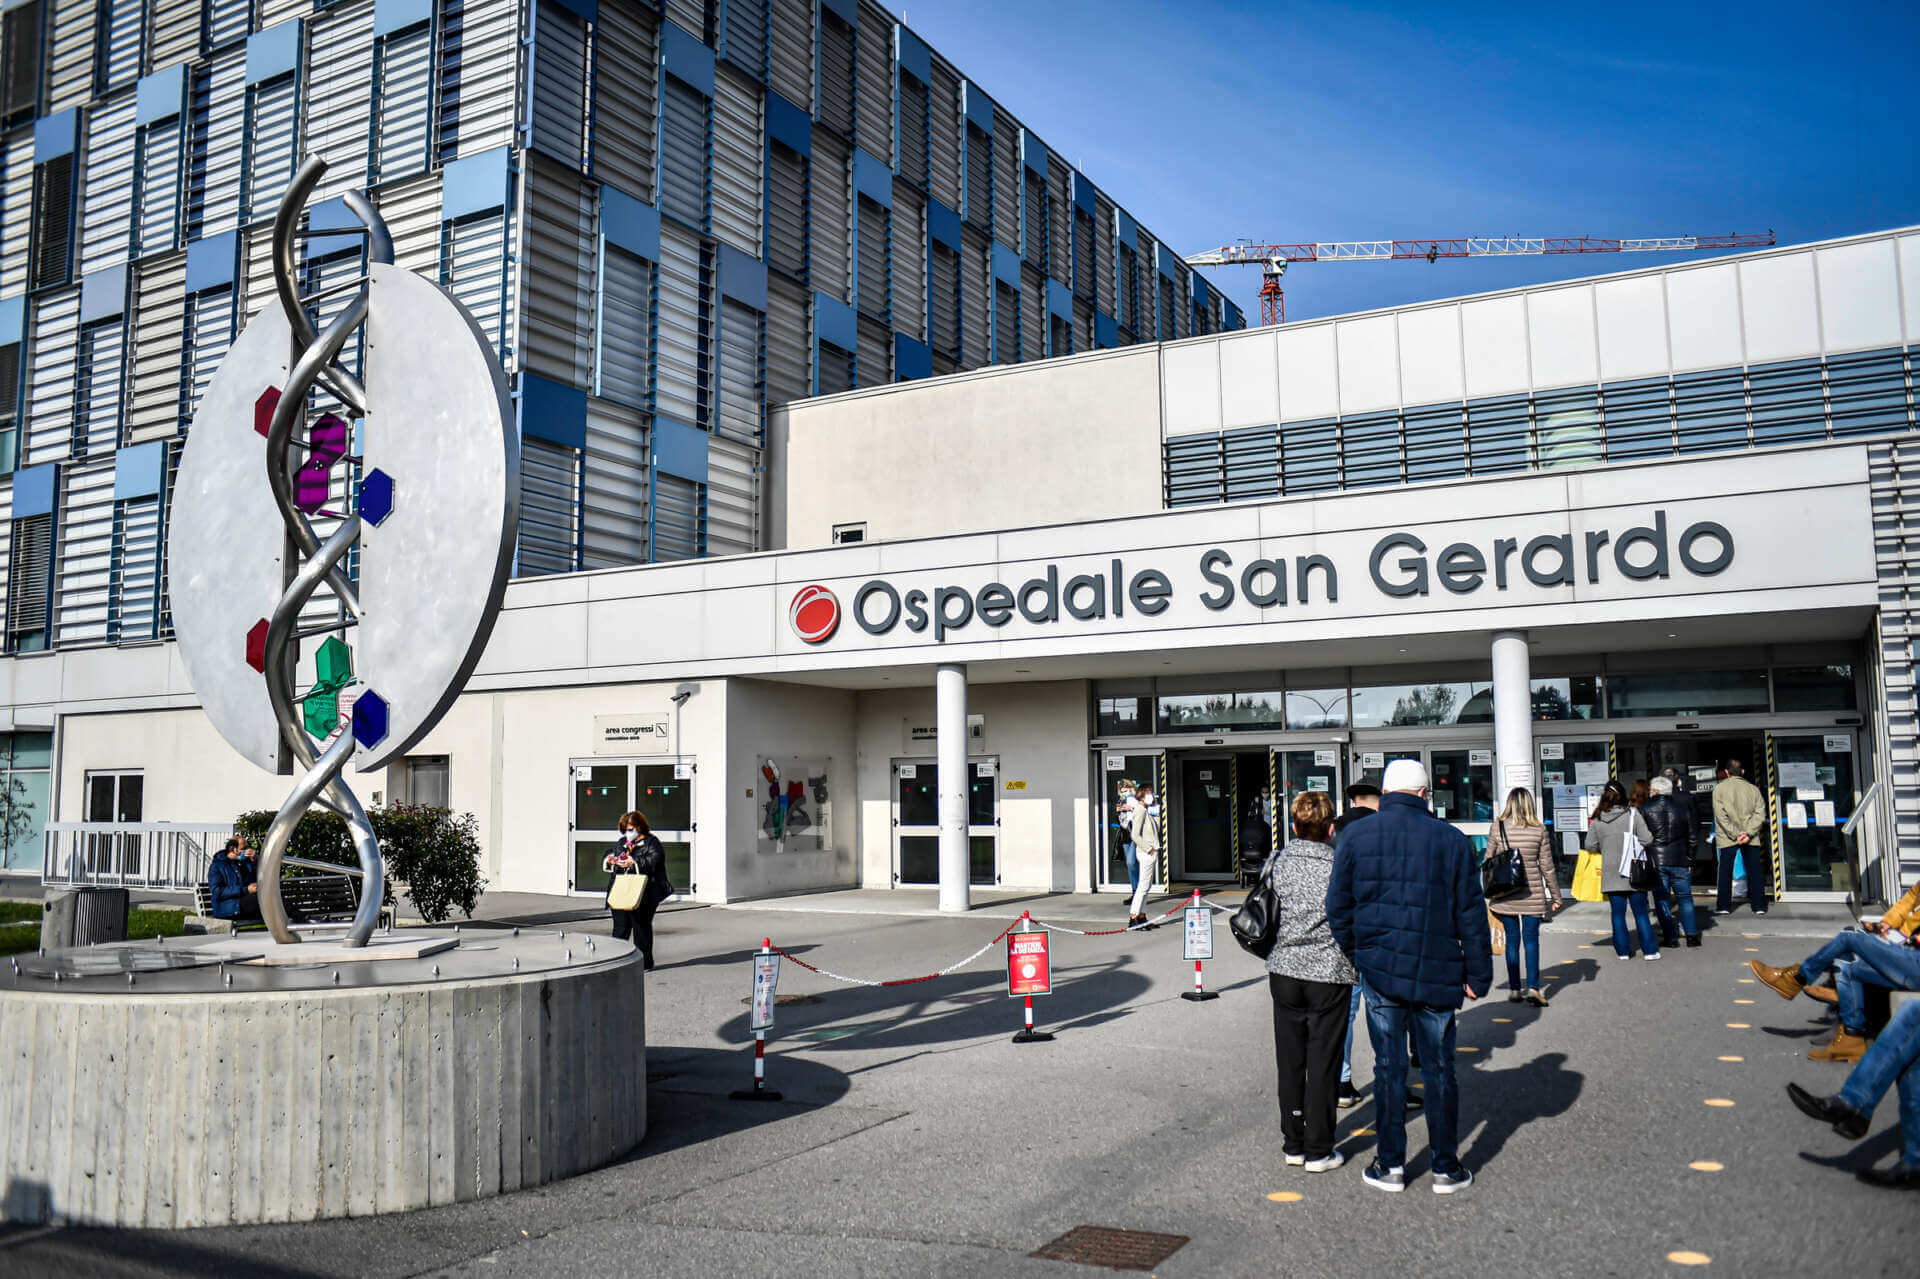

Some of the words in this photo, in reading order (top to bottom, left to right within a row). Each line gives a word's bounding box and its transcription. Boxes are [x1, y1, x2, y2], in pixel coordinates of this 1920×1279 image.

[853, 558, 1173, 643] Ospedale
[1199, 548, 1338, 611] San
[1368, 509, 1736, 599] Gerardo
